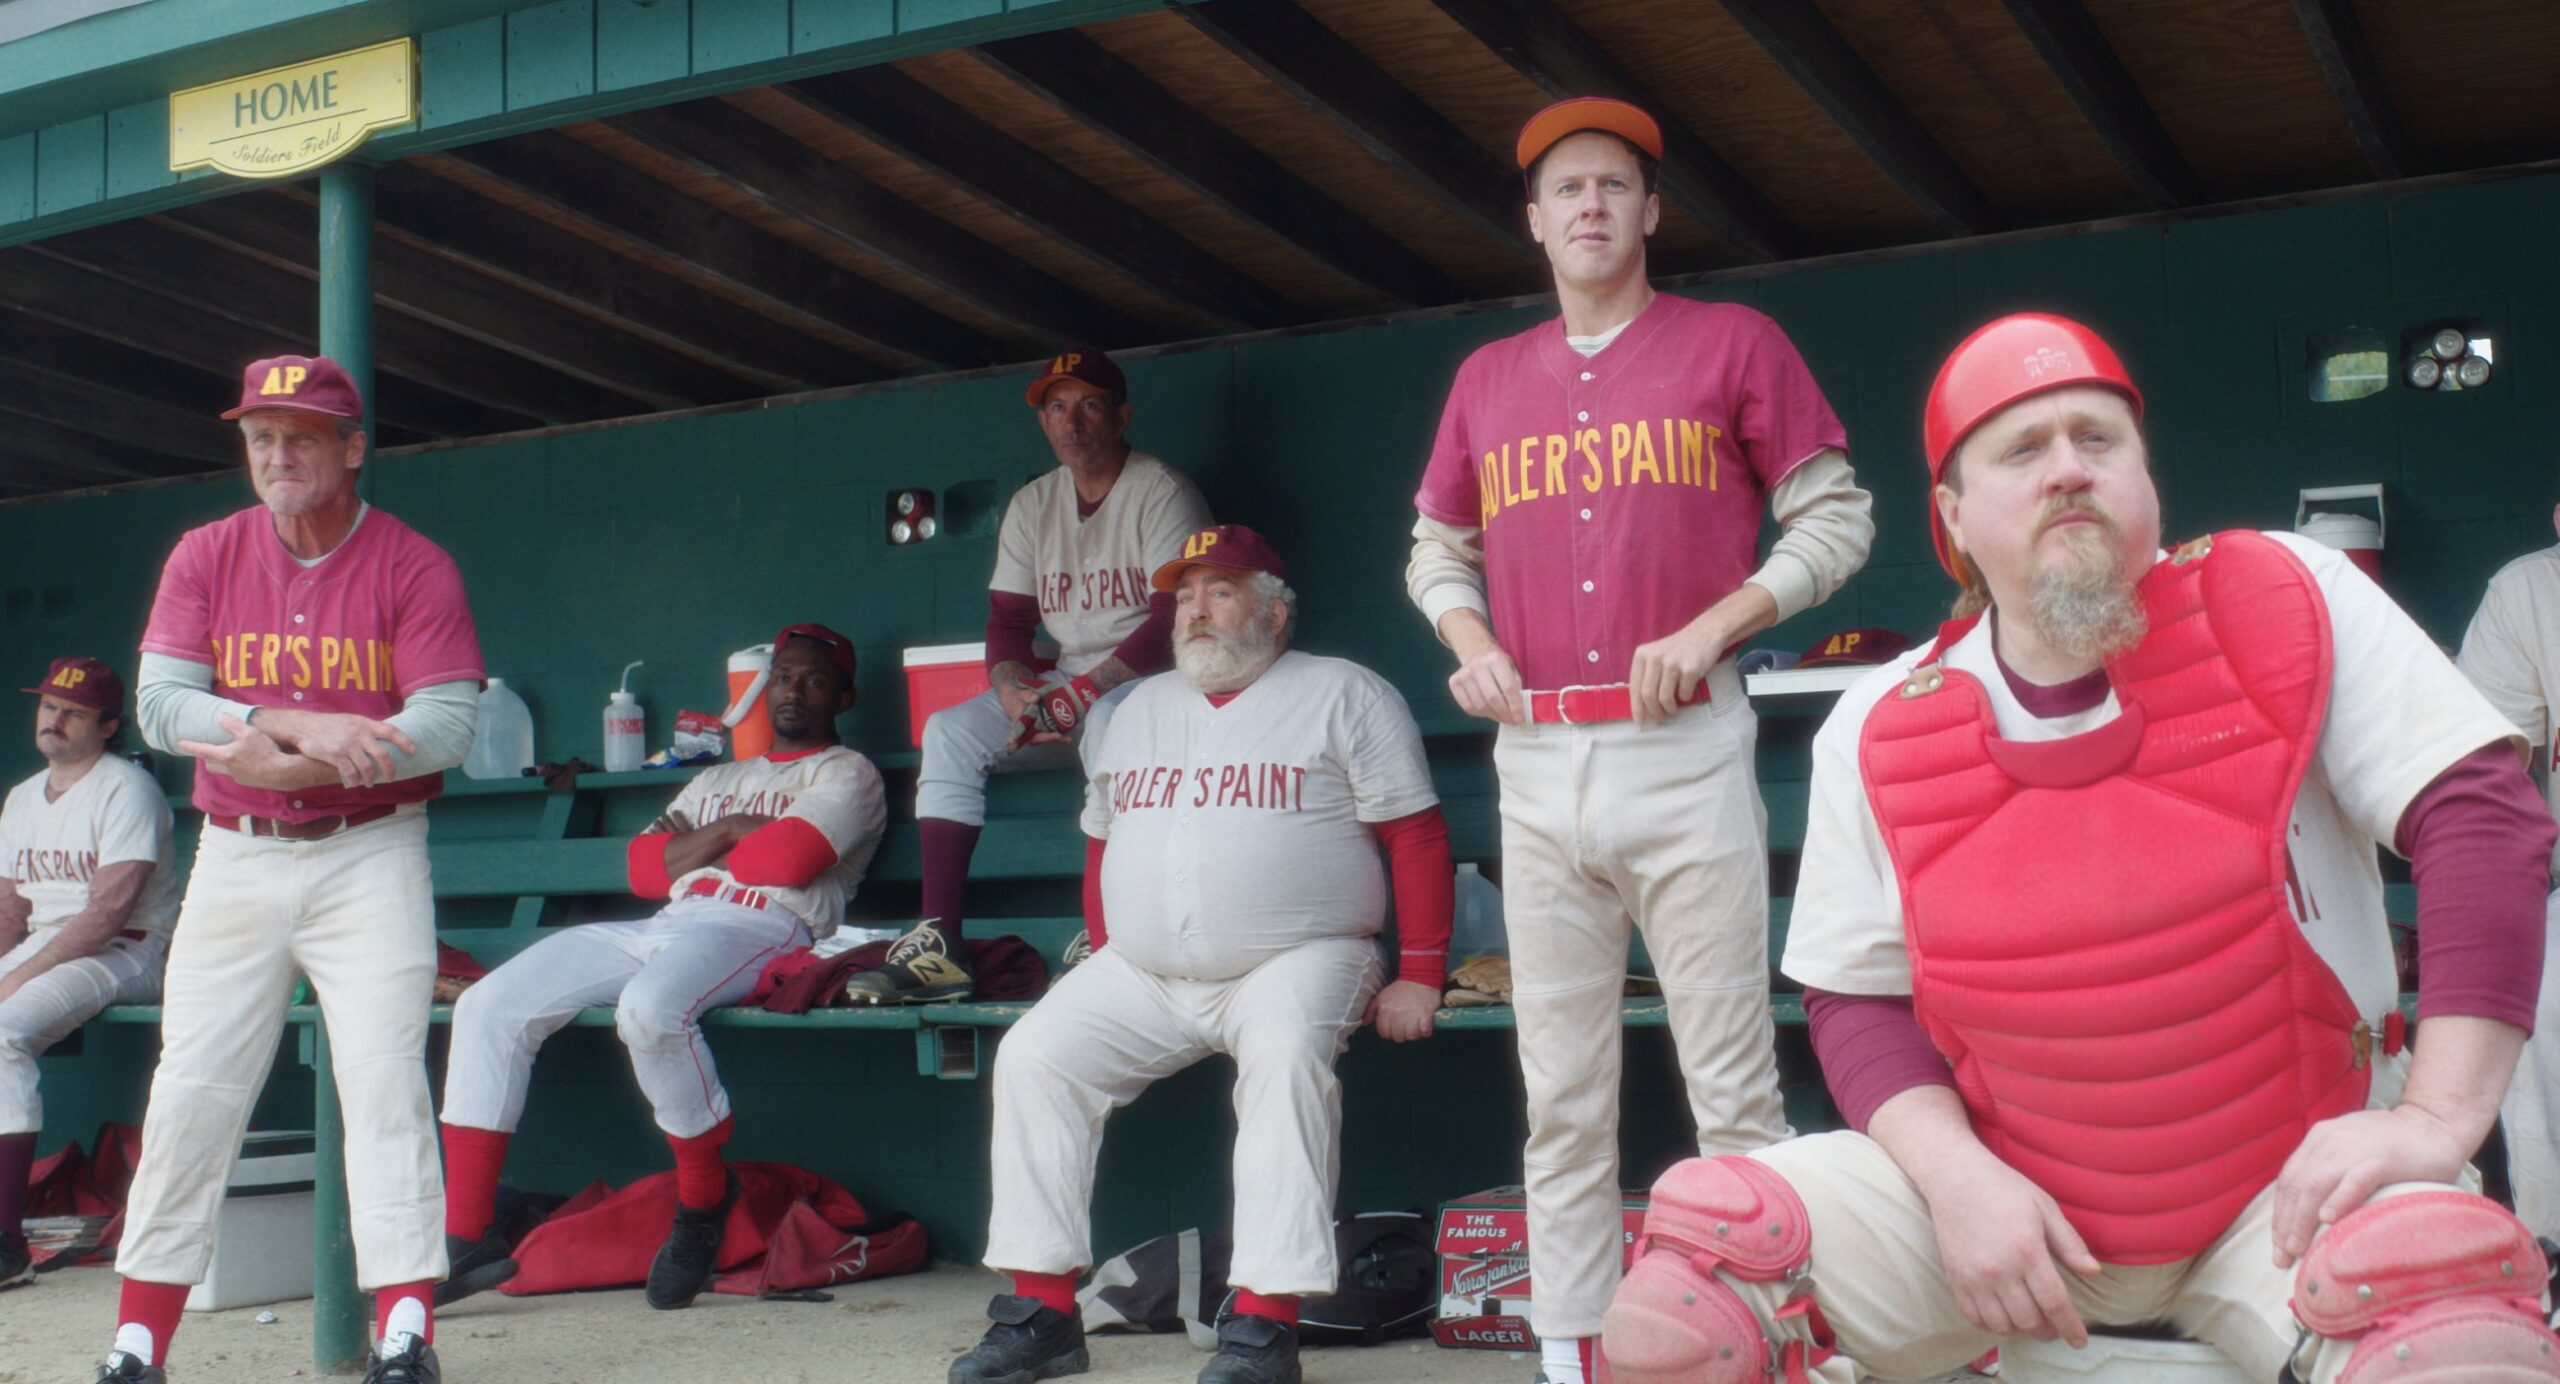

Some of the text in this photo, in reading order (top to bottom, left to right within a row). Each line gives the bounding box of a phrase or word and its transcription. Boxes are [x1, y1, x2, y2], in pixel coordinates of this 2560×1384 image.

[235, 70, 338, 128] HOME
[232, 122, 342, 165] Soldiers Field
[1052, 353, 1083, 374] AP
[260, 366, 306, 395] AP
[1479, 418, 1721, 531] ADLER'S PAINT
[1184, 531, 1218, 559] AP
[1824, 632, 1861, 655] AP
[51, 667, 86, 689] AP
[1216, 762, 1306, 812] PAINT
[1466, 1215, 1494, 1225] THE
[1446, 1228, 1507, 1238] FAMOUS
[1453, 1330, 1524, 1343] LAGER
